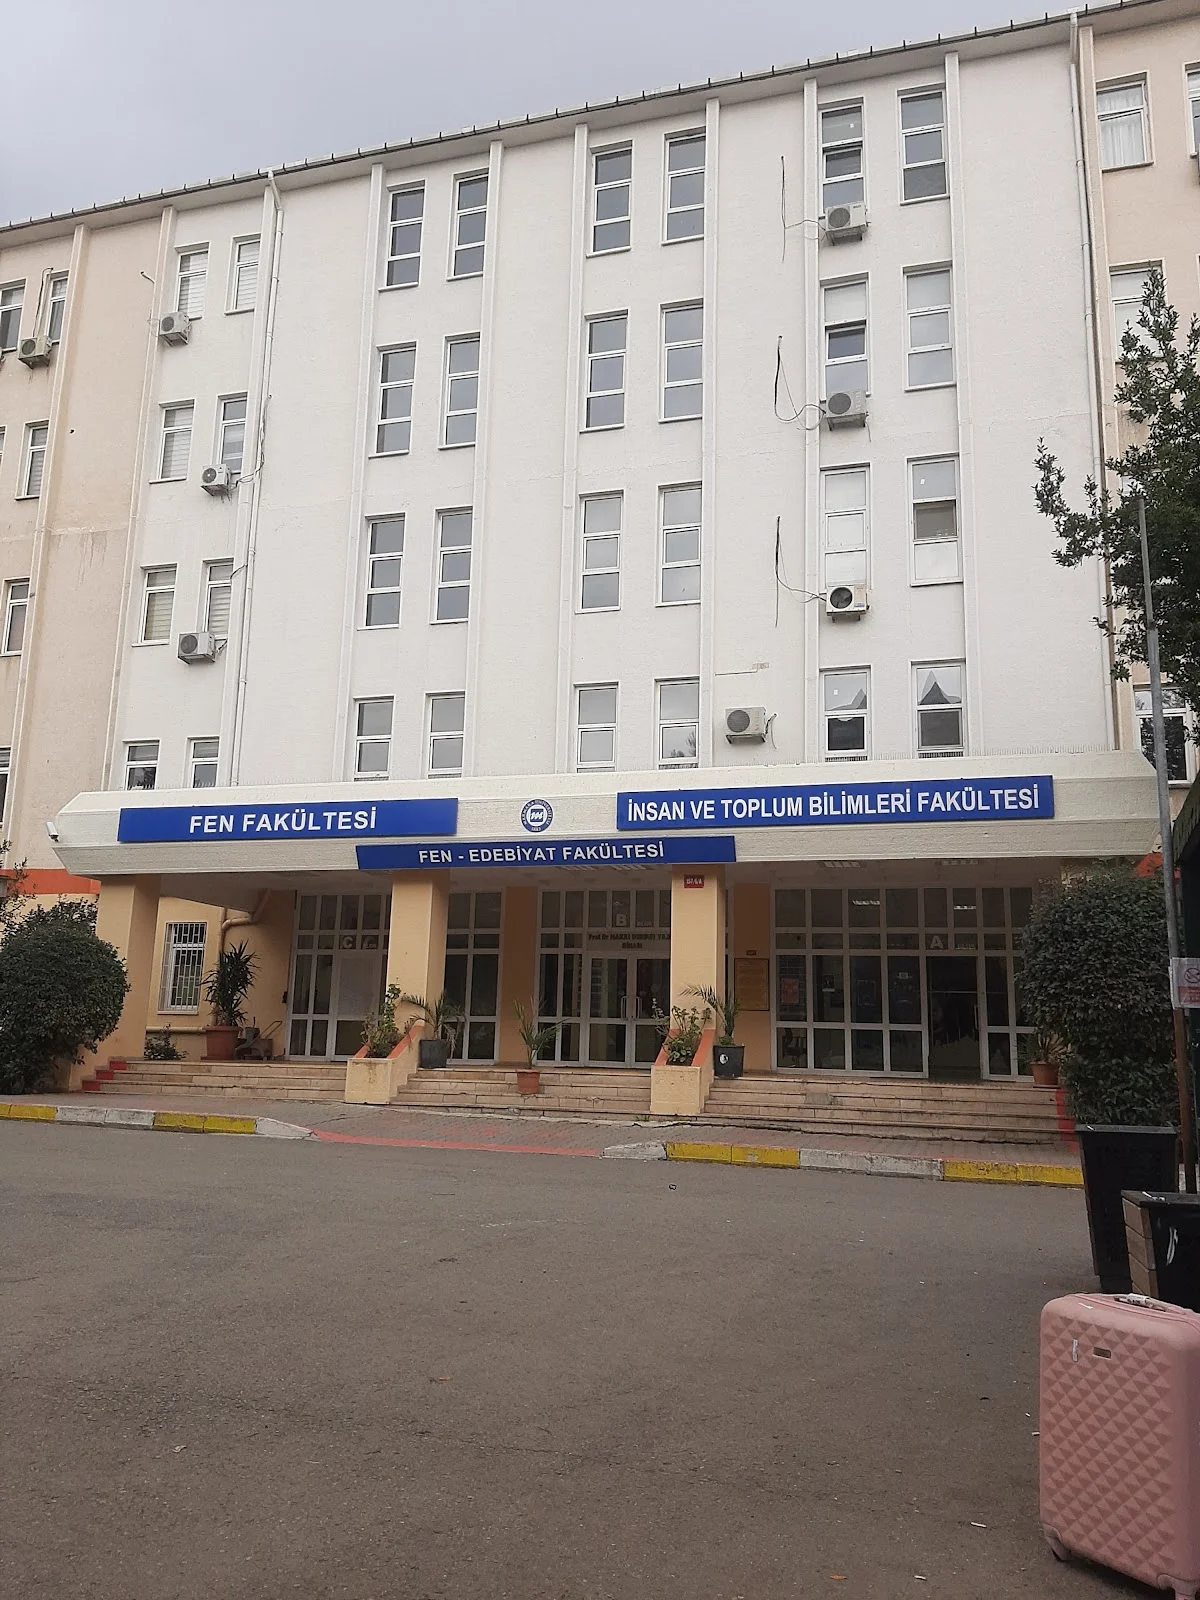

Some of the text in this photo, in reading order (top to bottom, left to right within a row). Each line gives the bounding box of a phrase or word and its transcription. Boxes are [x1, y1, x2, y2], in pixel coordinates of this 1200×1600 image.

[628, 784, 1038, 821] İNSAN VE TOPLUM BİLİMLERİ FAKÜLTESİ
[189, 807, 376, 833] FEN FAKÜLTESİ
[419, 850, 452, 863] FEN
[469, 846, 556, 862] EDEBİYAT
[563, 841, 664, 859] FAKÜLTESİ
[615, 913, 627, 927] B
[343, 936, 353, 949] C
[930, 935, 944, 949] A
